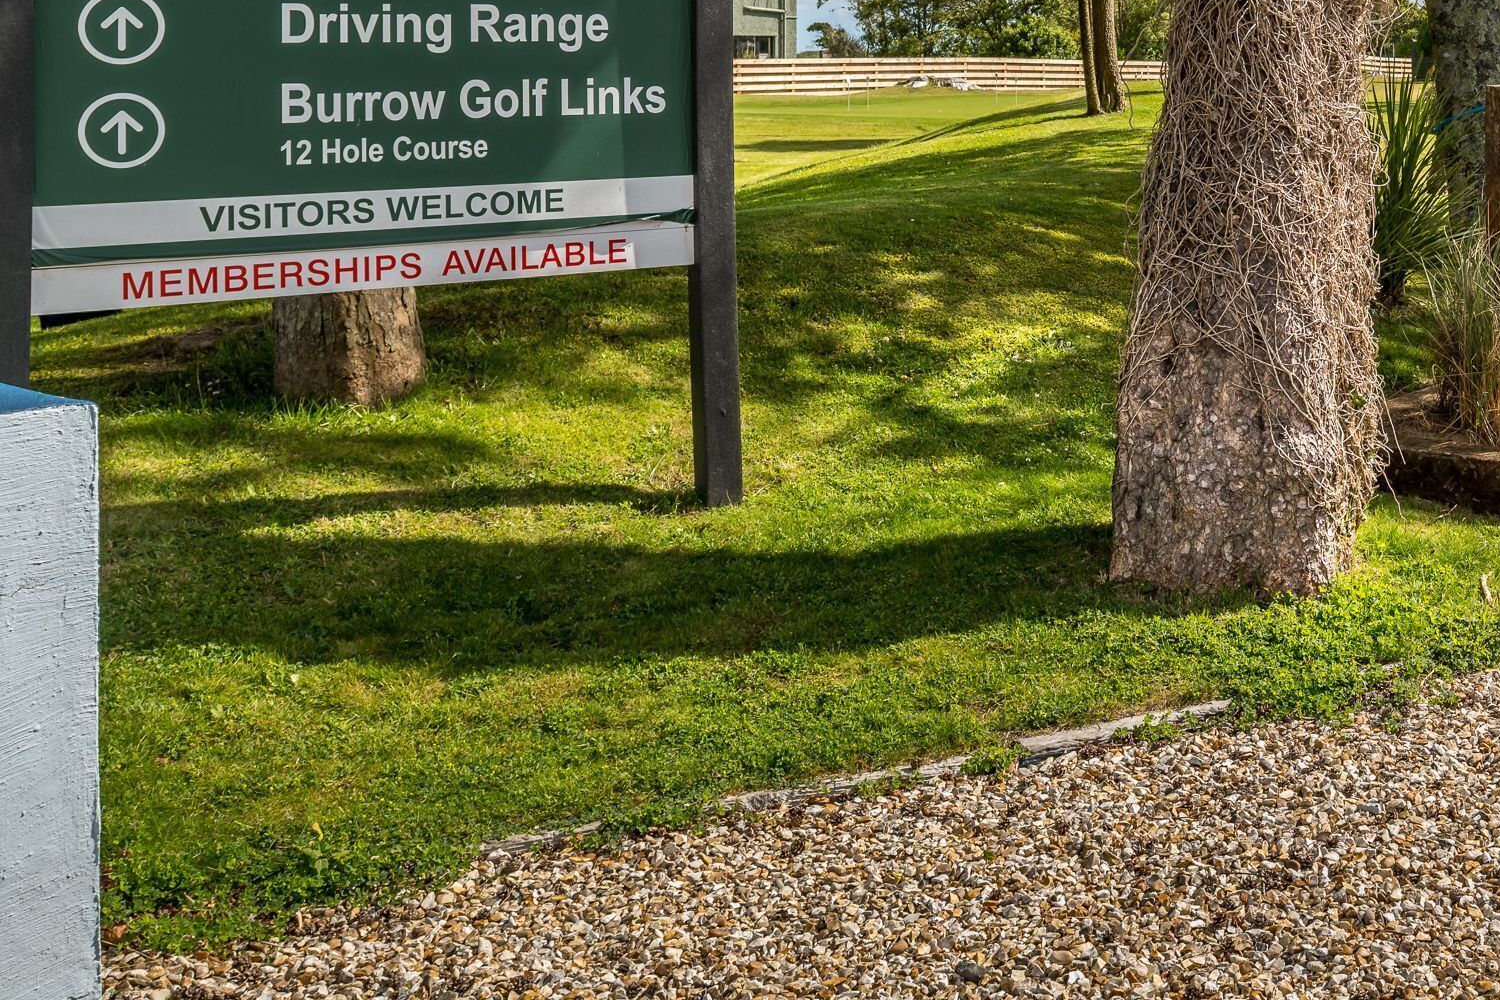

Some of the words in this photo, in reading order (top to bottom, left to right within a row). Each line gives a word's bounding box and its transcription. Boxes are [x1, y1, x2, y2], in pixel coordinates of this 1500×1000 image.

[281, 3, 453, 54] Driving
[470, 4, 610, 53] Range
[281, 82, 446, 124] Burrow
[459, 78, 549, 119] Golf
[561, 76, 667, 116] Links
[280, 139, 312, 166] 12
[322, 137, 385, 164] Hole
[392, 135, 489, 162] Course
[200, 196, 376, 233] VISITORS
[386, 187, 565, 224] WELCOME
[121, 252, 423, 301] MEMBERSHIPS
[442, 238, 628, 277] AVAILABLE
